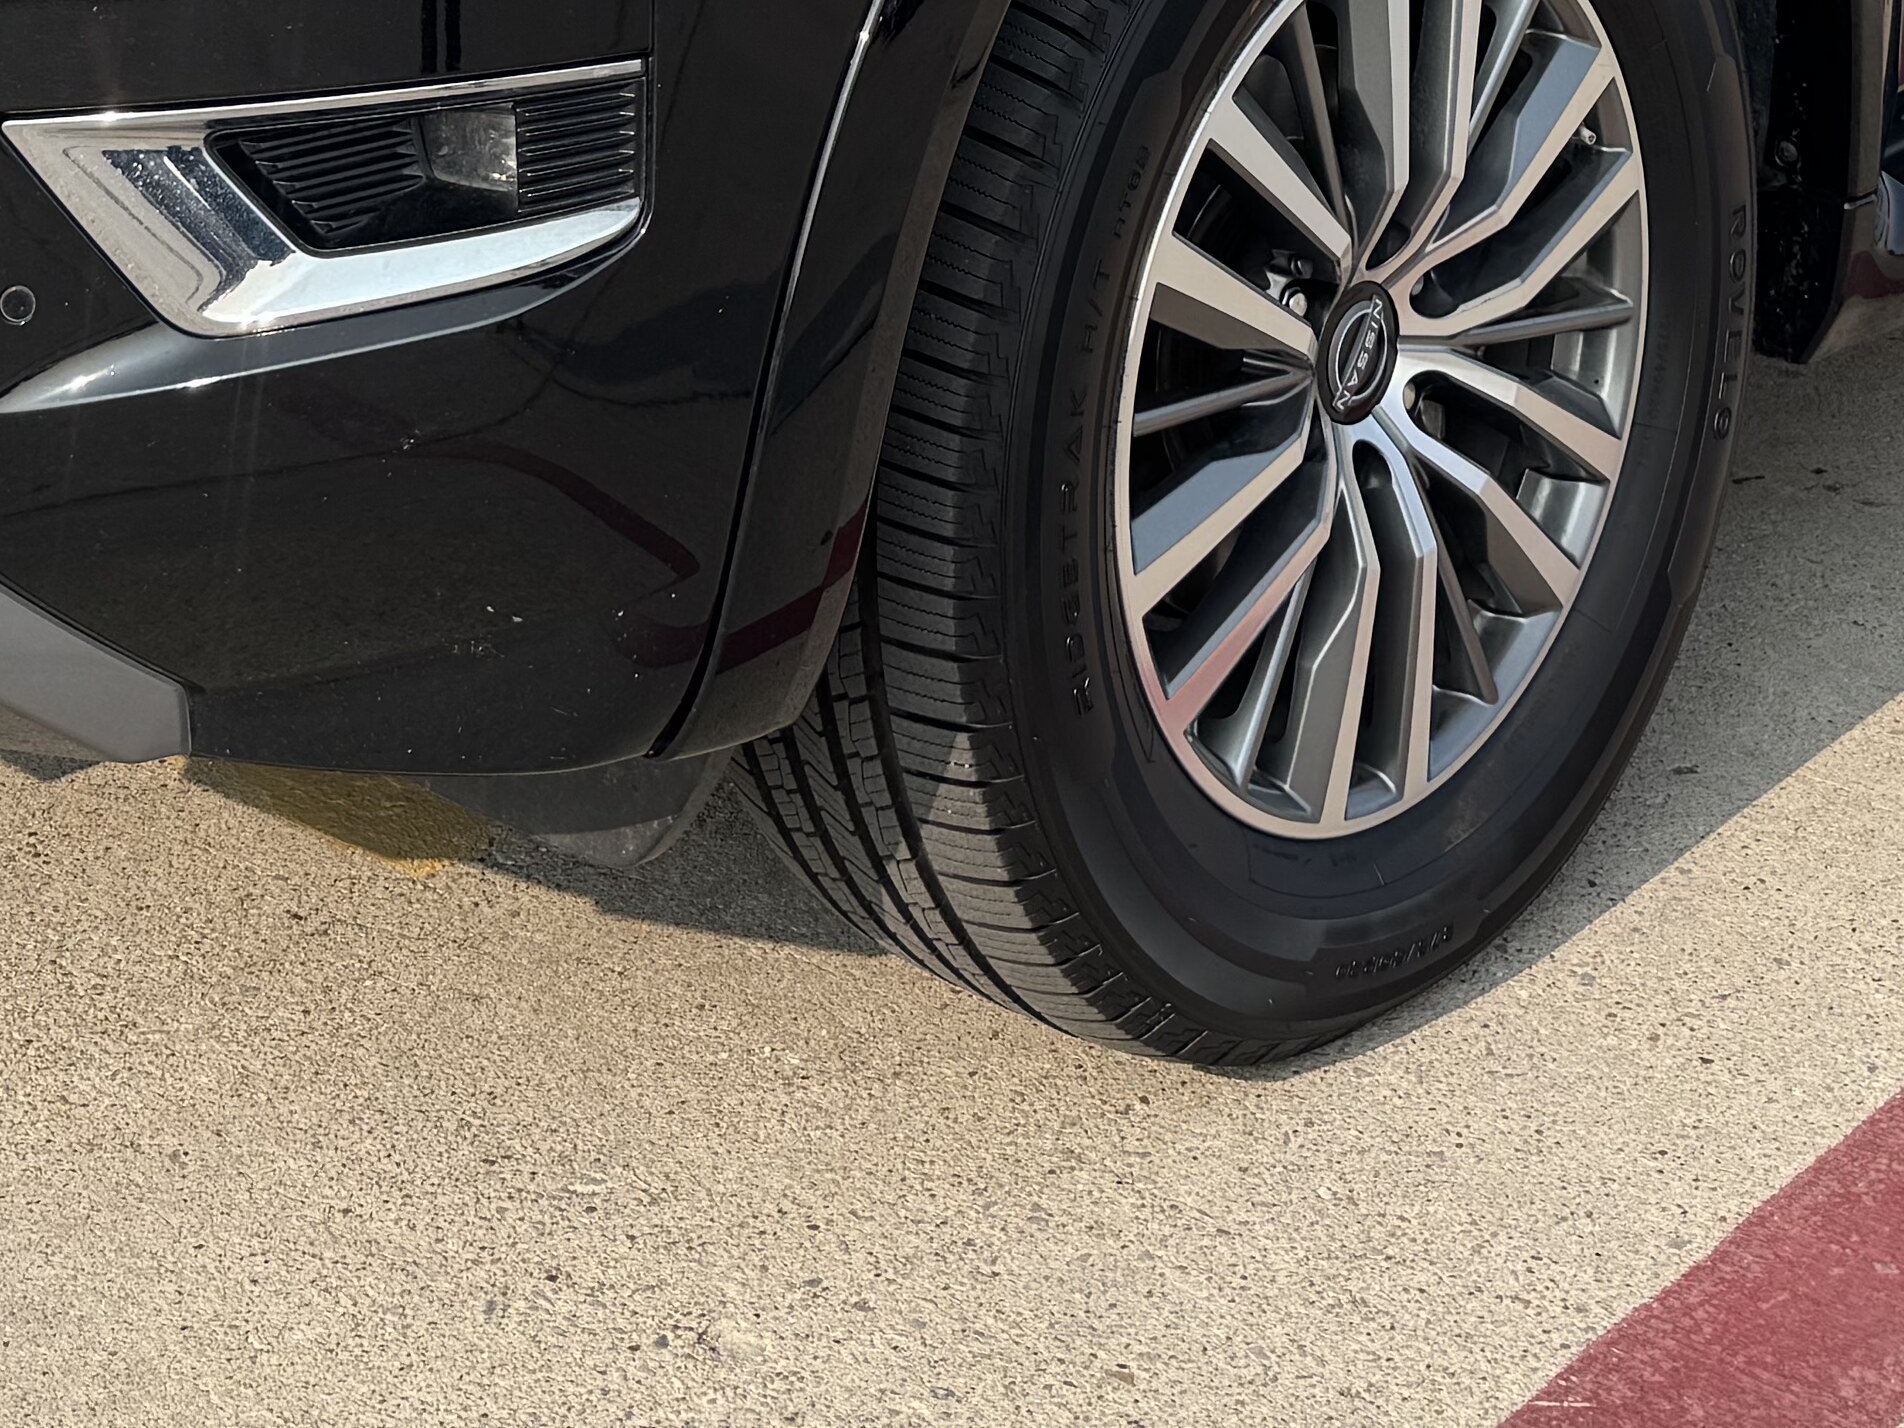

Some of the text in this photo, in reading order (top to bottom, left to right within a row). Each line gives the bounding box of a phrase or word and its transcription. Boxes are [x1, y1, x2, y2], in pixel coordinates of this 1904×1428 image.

[1332, 297, 1385, 411] NISSAN
[1713, 204, 1747, 440] ROVELO
[1055, 256, 1111, 719] RIDGETRAK H/T
